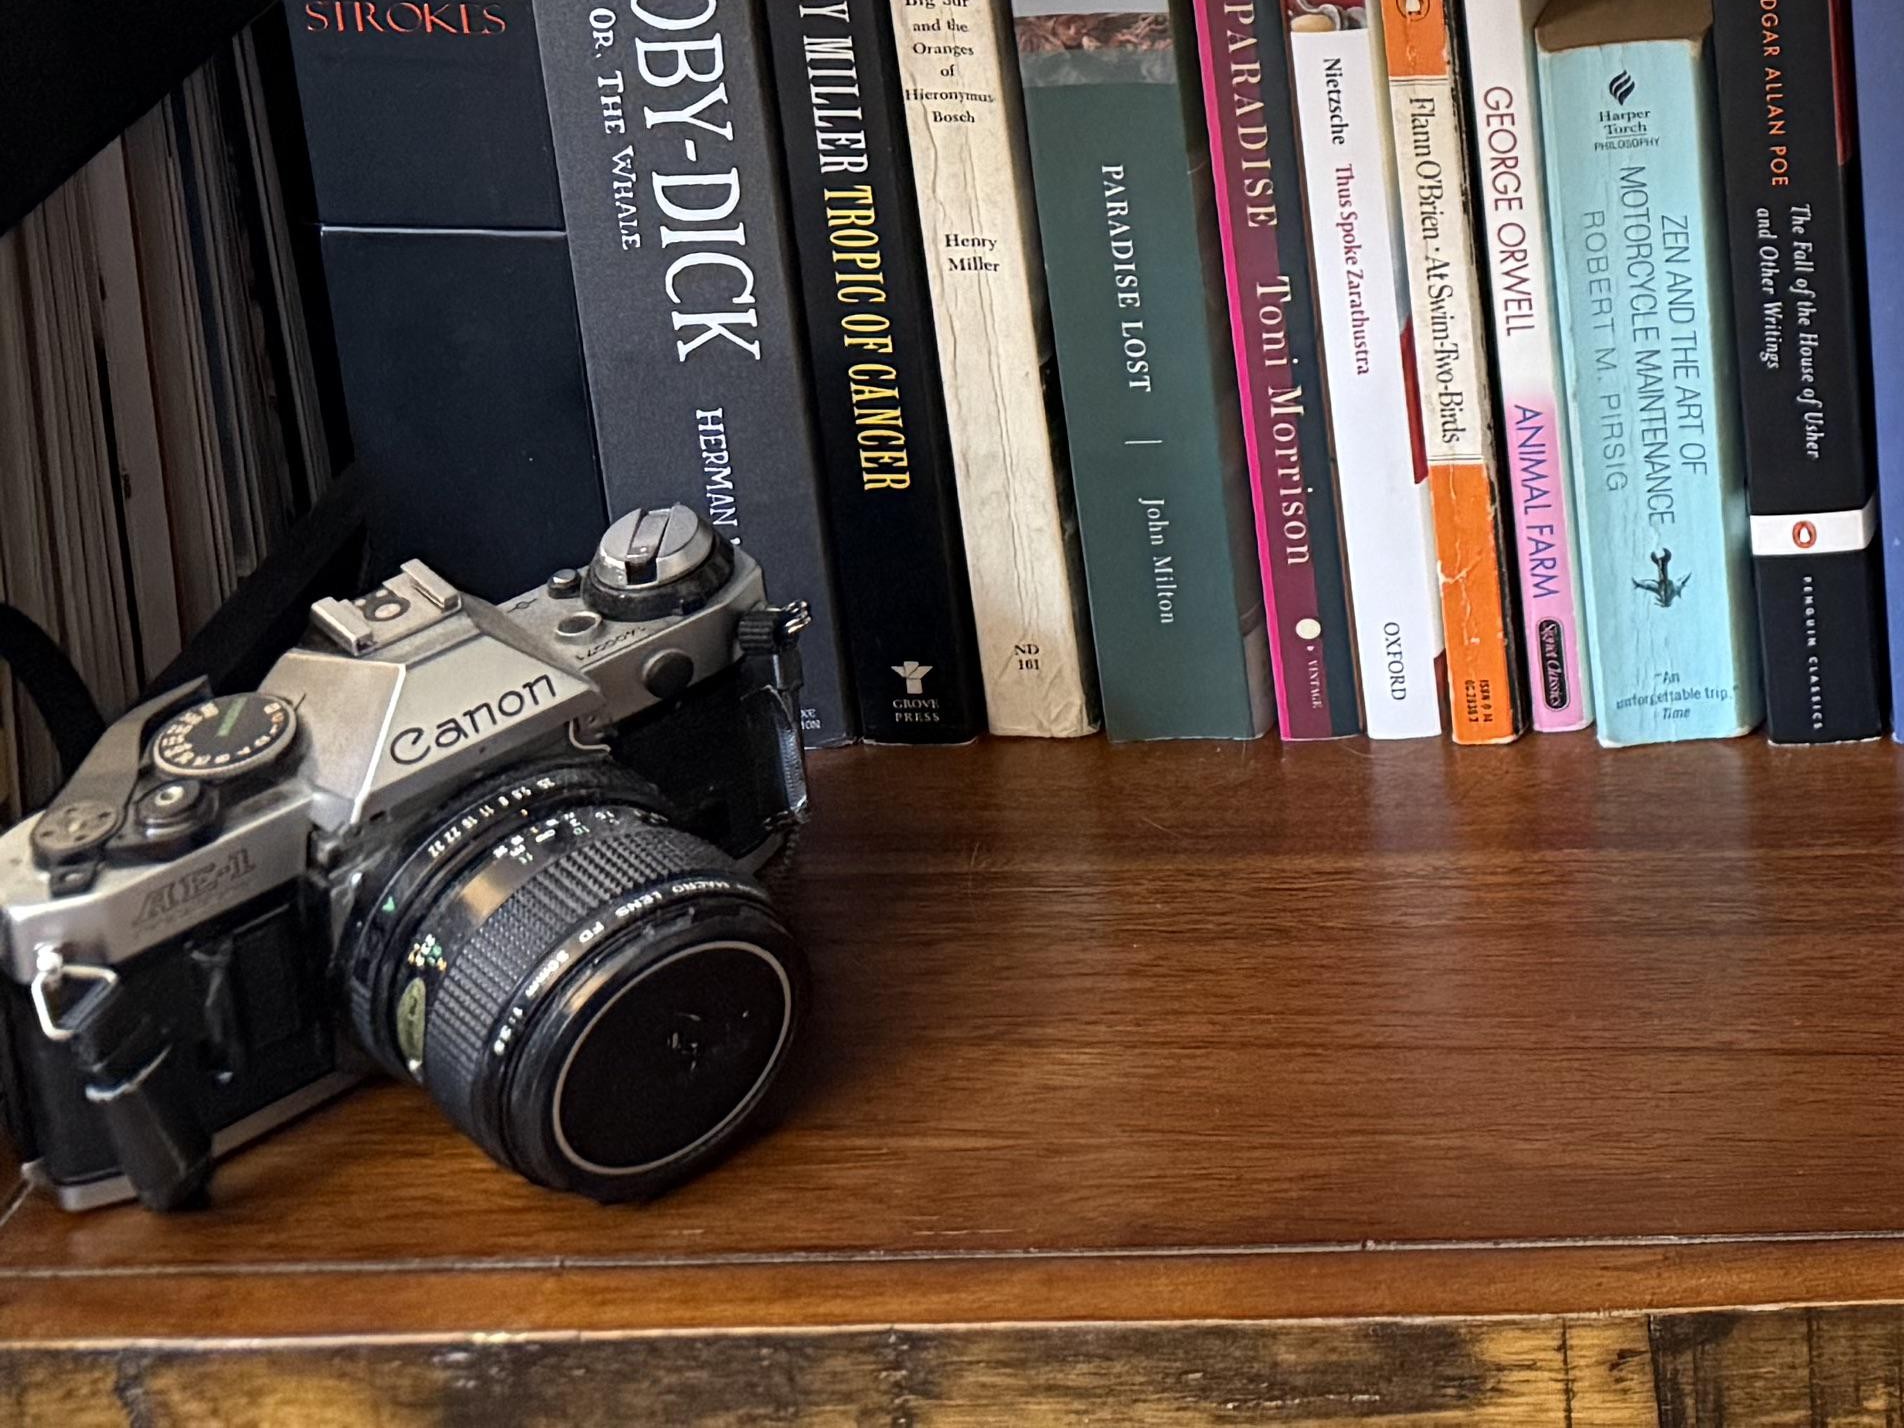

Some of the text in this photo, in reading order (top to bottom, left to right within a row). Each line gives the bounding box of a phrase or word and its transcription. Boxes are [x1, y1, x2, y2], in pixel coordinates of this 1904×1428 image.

[588, 6, 641, 252] OR, THE WHALE
[802, 34, 870, 174] MILLER
[932, 109, 976, 124] Bosch
[1222, 2, 1279, 229] PARADISE
[1322, 58, 1346, 145] Nietzsche
[945, 233, 998, 254] Henry
[948, 255, 1000, 272] Miller
[1484, 85, 1536, 336] GEORGE ORWELL
[824, 185, 912, 492] TROPIC OF CANCER
[1254, 274, 1314, 568] Toni Morrison
[1512, 404, 1559, 600] ANIMAL FARM
[389, 673, 556, 764] Canon
